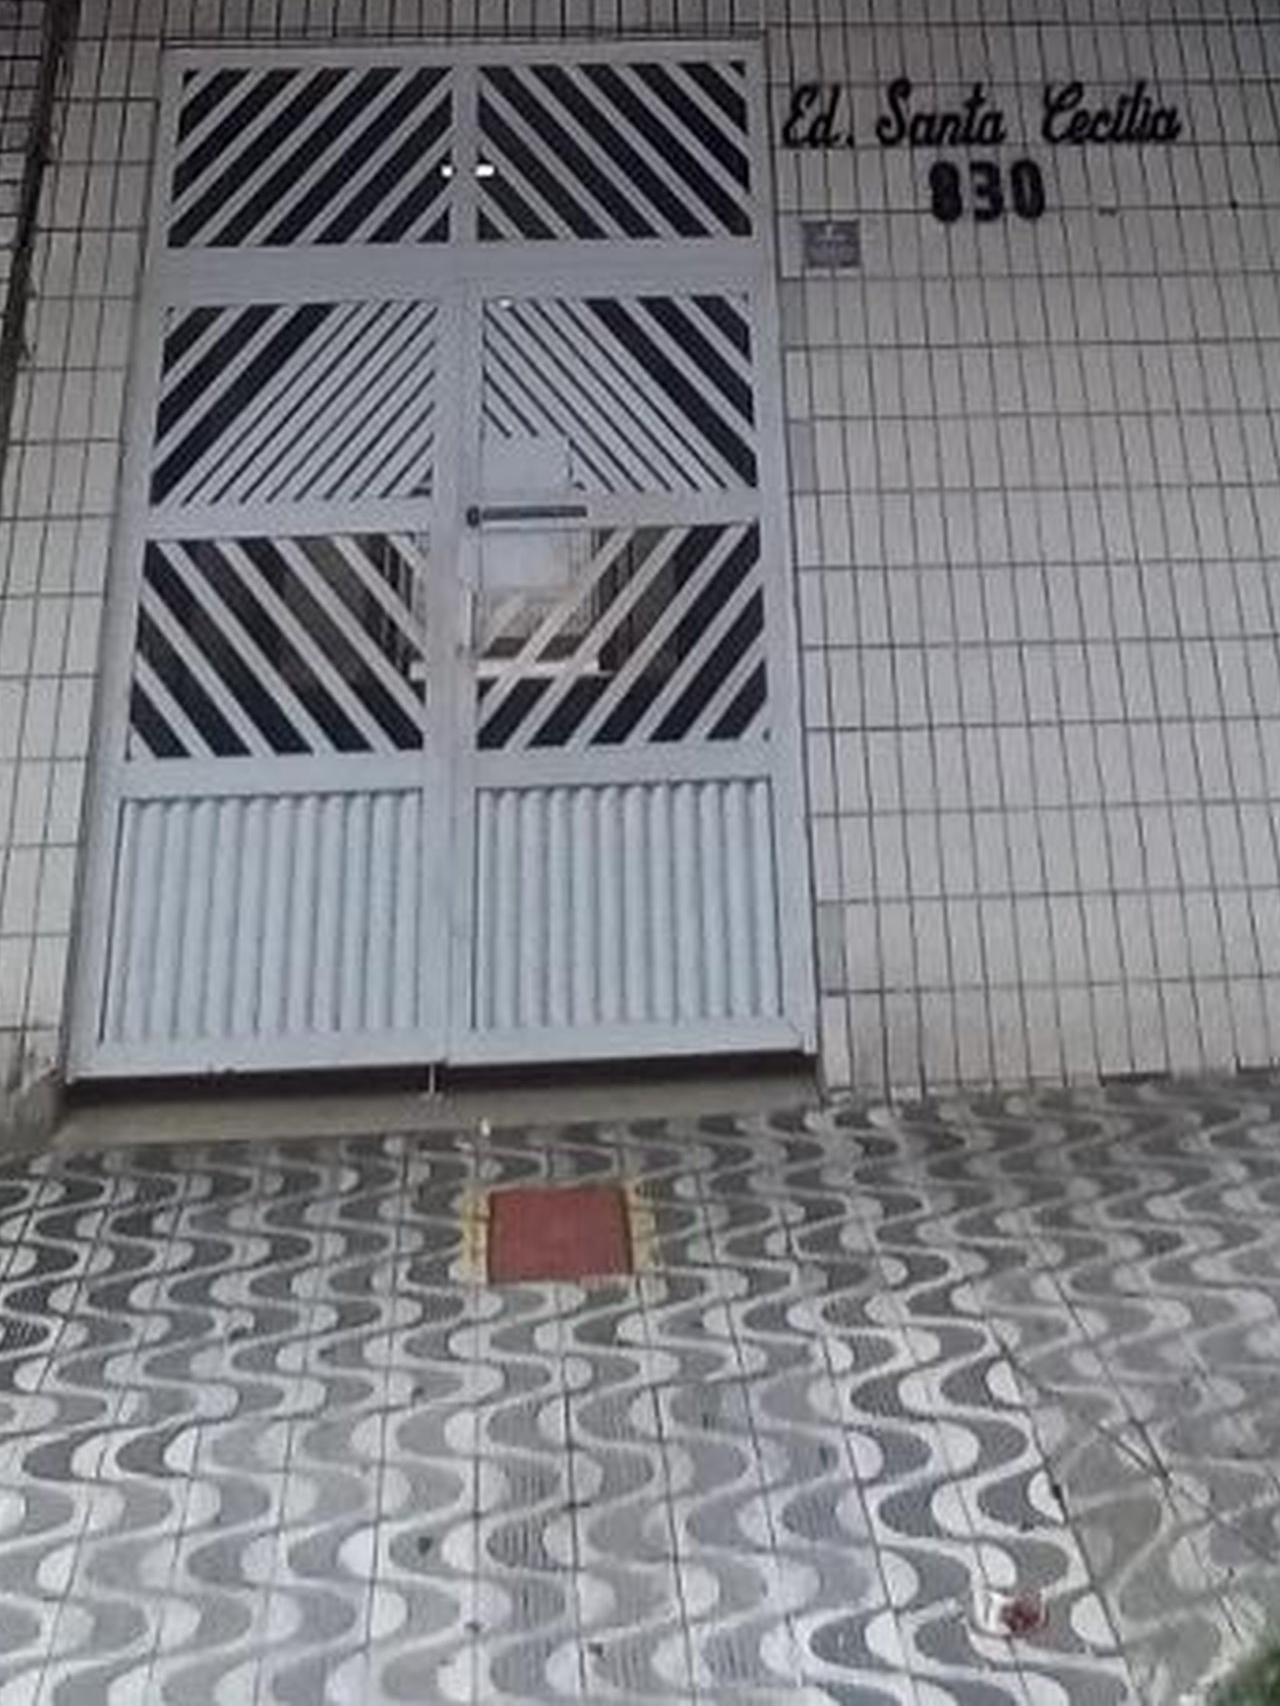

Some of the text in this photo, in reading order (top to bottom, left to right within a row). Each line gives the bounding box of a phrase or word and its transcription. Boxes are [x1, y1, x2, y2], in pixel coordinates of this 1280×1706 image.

[781, 83, 856, 149] Ed.
[876, 77, 1009, 147] Santa
[927, 158, 1047, 223] 830
